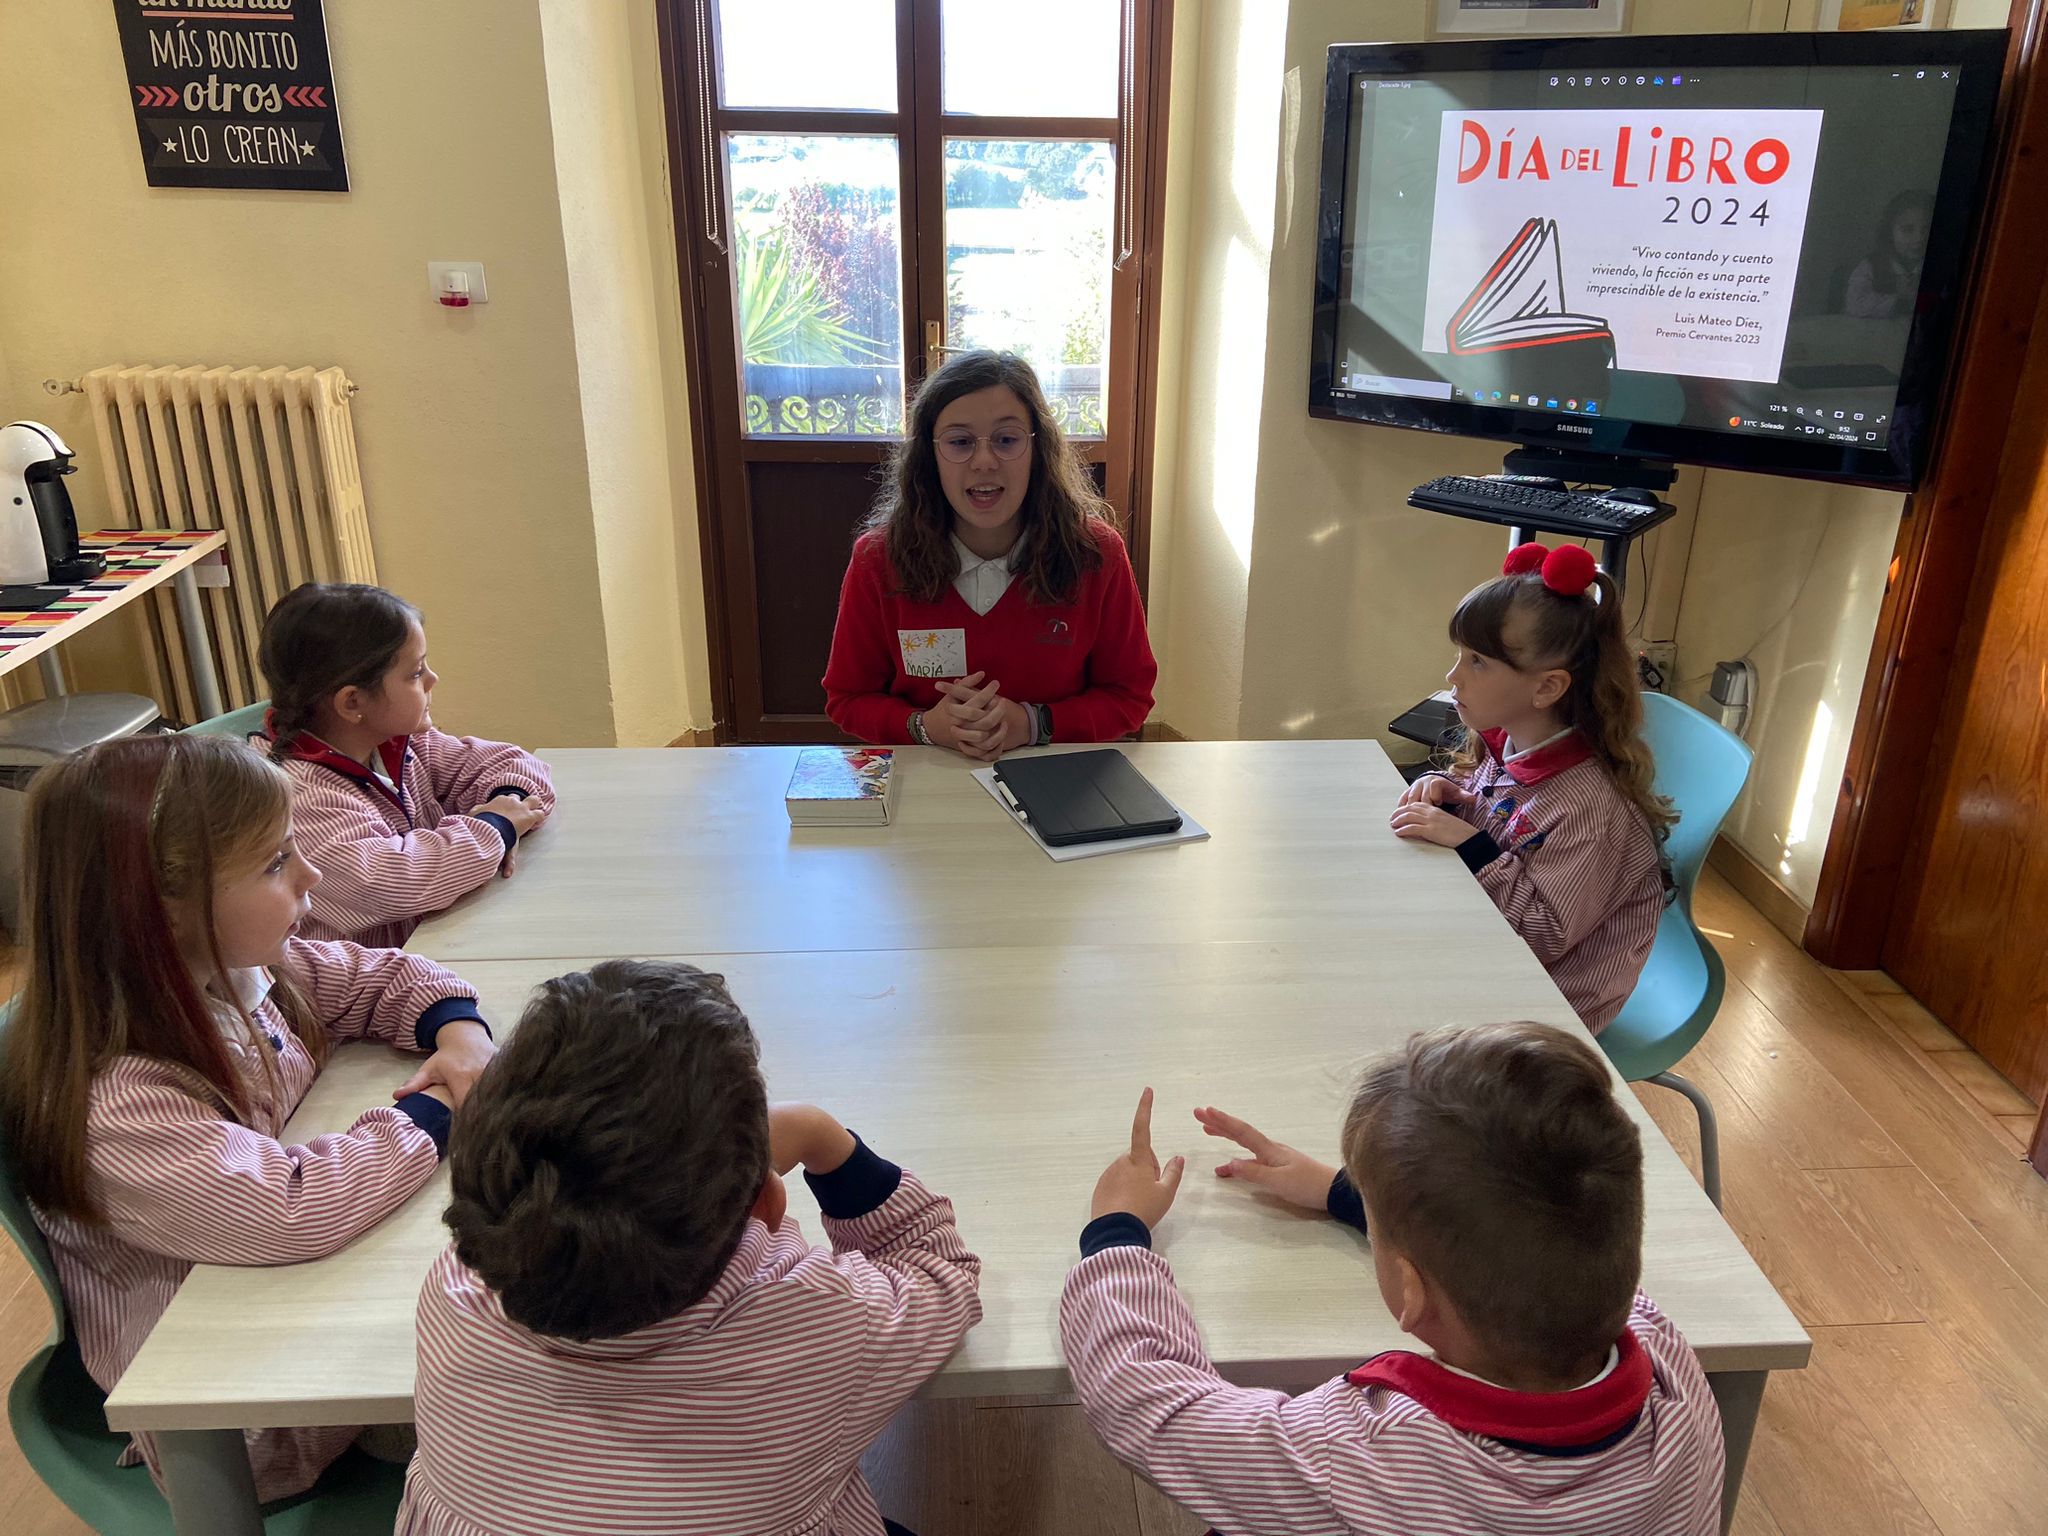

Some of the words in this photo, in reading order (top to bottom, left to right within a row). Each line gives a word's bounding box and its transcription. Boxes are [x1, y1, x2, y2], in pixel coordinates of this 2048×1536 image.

[150, 19, 203, 69] MÁS
[206, 30, 298, 70] BONITO
[183, 74, 283, 113] otros
[179, 125, 210, 163] LO
[224, 125, 301, 164] CREAN
[1457, 119, 1550, 184] DÍA
[1560, 148, 1604, 172] DEL
[1662, 196, 1770, 227] 2024
[1665, 249, 1719, 262] contando
[1720, 252, 1730, 266] y
[1732, 253, 1774, 265] cuento
[1592, 263, 1639, 279] viviendo,
[1642, 265, 1653, 278] la
[1655, 265, 1694, 283] ficción
[1697, 272, 1709, 281] es
[1712, 273, 1734, 283] una
[1736, 274, 1771, 287] parte
[1586, 280, 1666, 297] imprescindible
[1668, 286, 1682, 299] de
[1684, 287, 1695, 299] la
[1674, 312, 1695, 325] Luis
[1699, 314, 1733, 327] Mateo
[1656, 327, 1686, 340] Premio
[1688, 330, 1733, 343] Cervantes
[1734, 334, 1760, 344] 2023
[1557, 424, 1594, 435] SAMSUNG
[1760, 421, 1785, 431] Soleado
